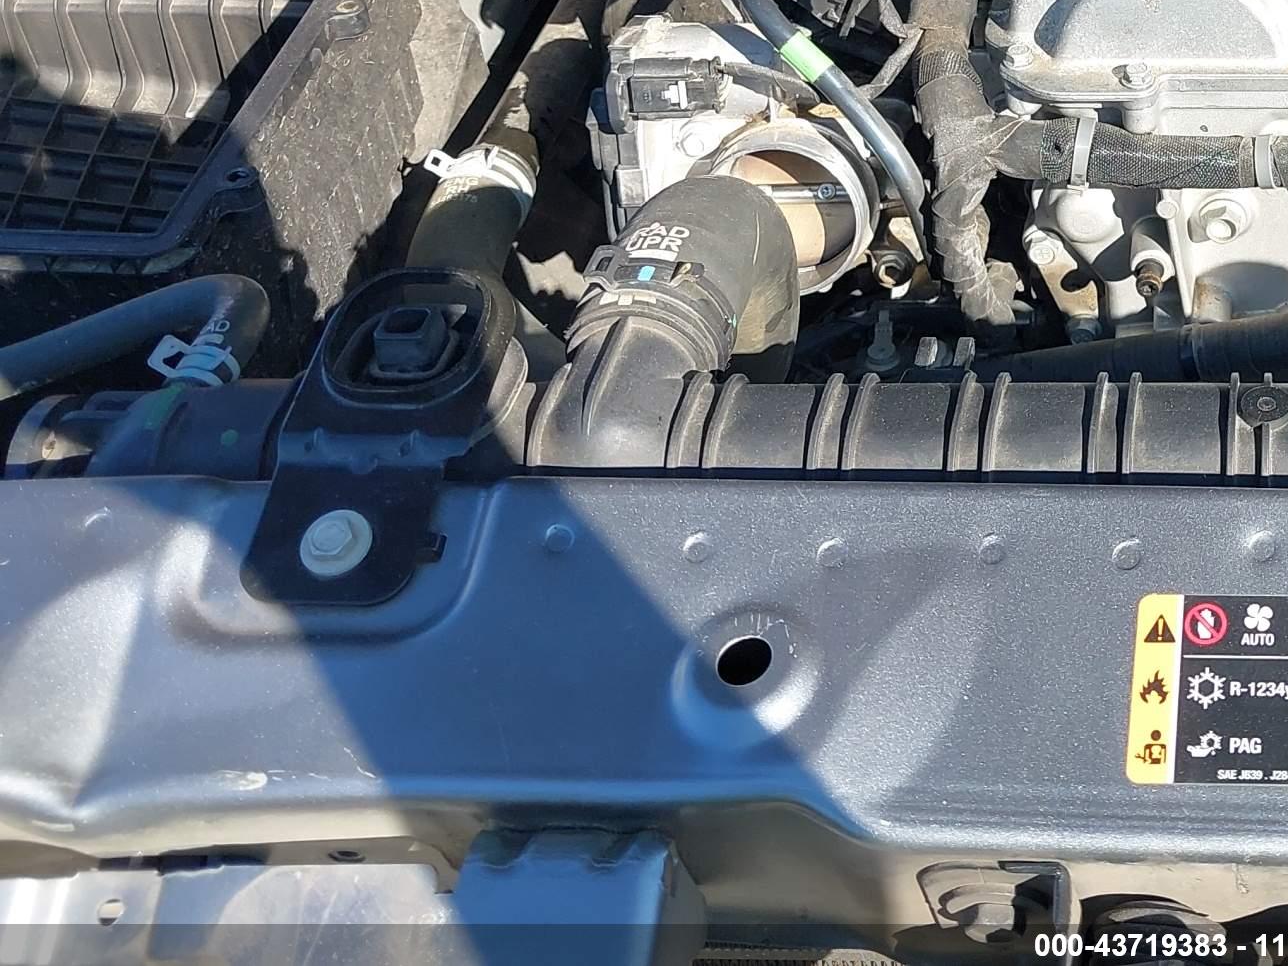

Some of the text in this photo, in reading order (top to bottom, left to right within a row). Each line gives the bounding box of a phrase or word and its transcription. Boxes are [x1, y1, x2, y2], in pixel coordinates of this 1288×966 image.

[631, 222, 690, 241] RAD
[625, 236, 683, 252] UPR
[1241, 633, 1275, 646] AUTO
[1229, 737, 1262, 754] PAG
[1217, 769, 1238, 780] SAE
